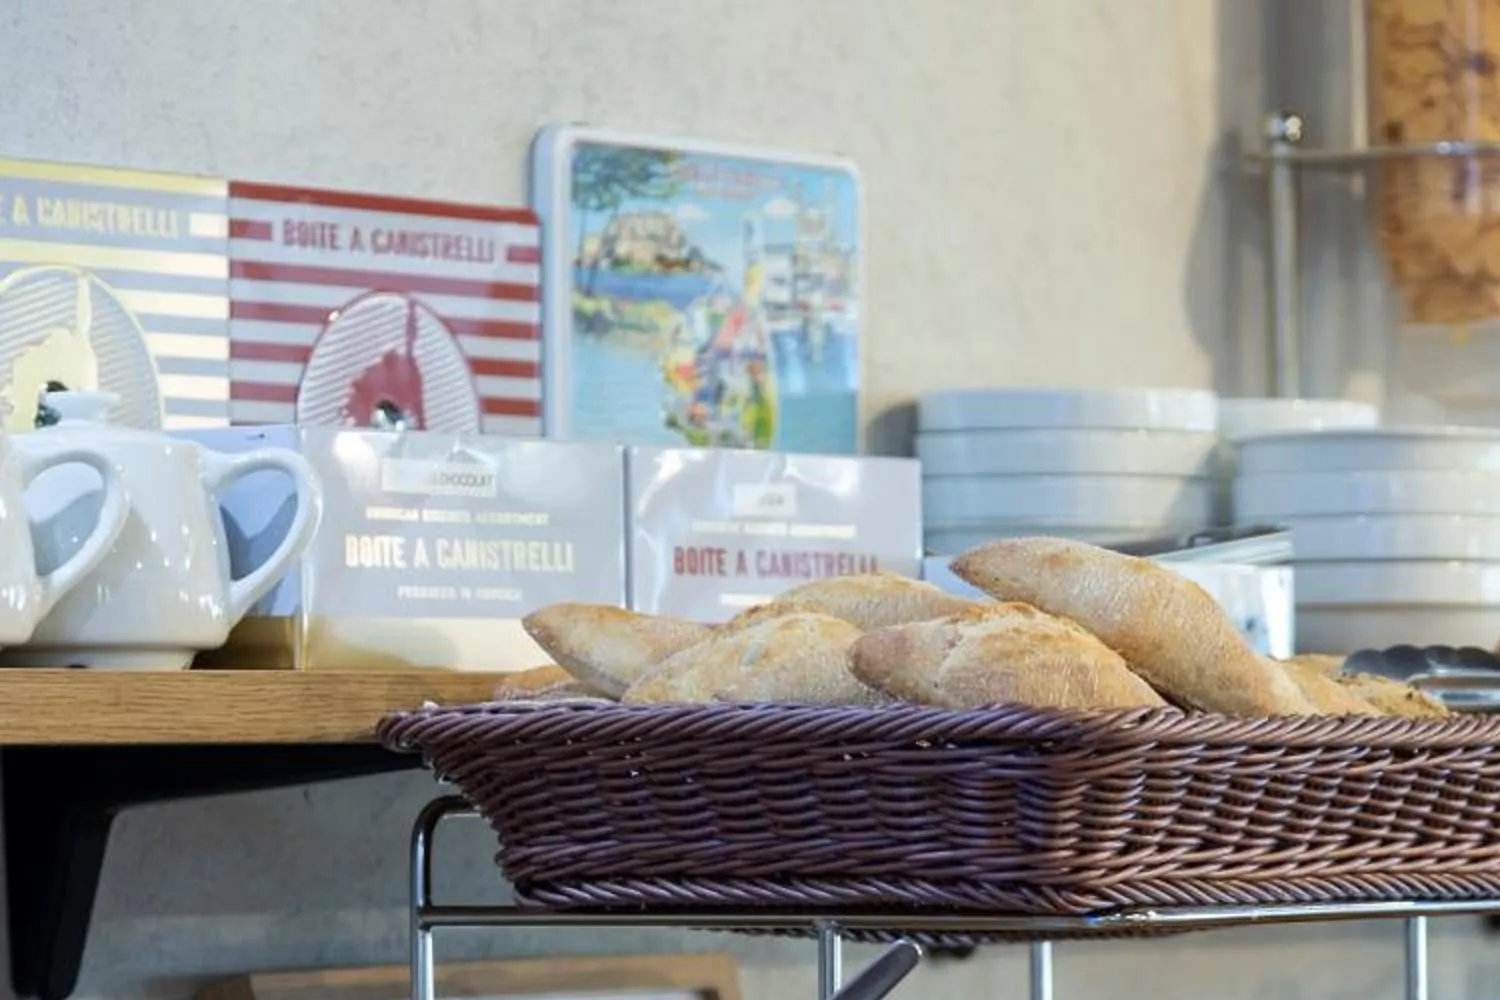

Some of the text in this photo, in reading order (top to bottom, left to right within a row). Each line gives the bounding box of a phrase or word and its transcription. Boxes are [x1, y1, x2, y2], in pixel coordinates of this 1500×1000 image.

[13, 194, 29, 226] A
[37, 196, 178, 240] CANISTRELLI
[283, 218, 495, 264] BOITE A CANISTRELLI
[345, 534, 574, 573] BOITE A CANISTRELLI
[673, 546, 728, 576] BOITE
[735, 549, 748, 576] A
